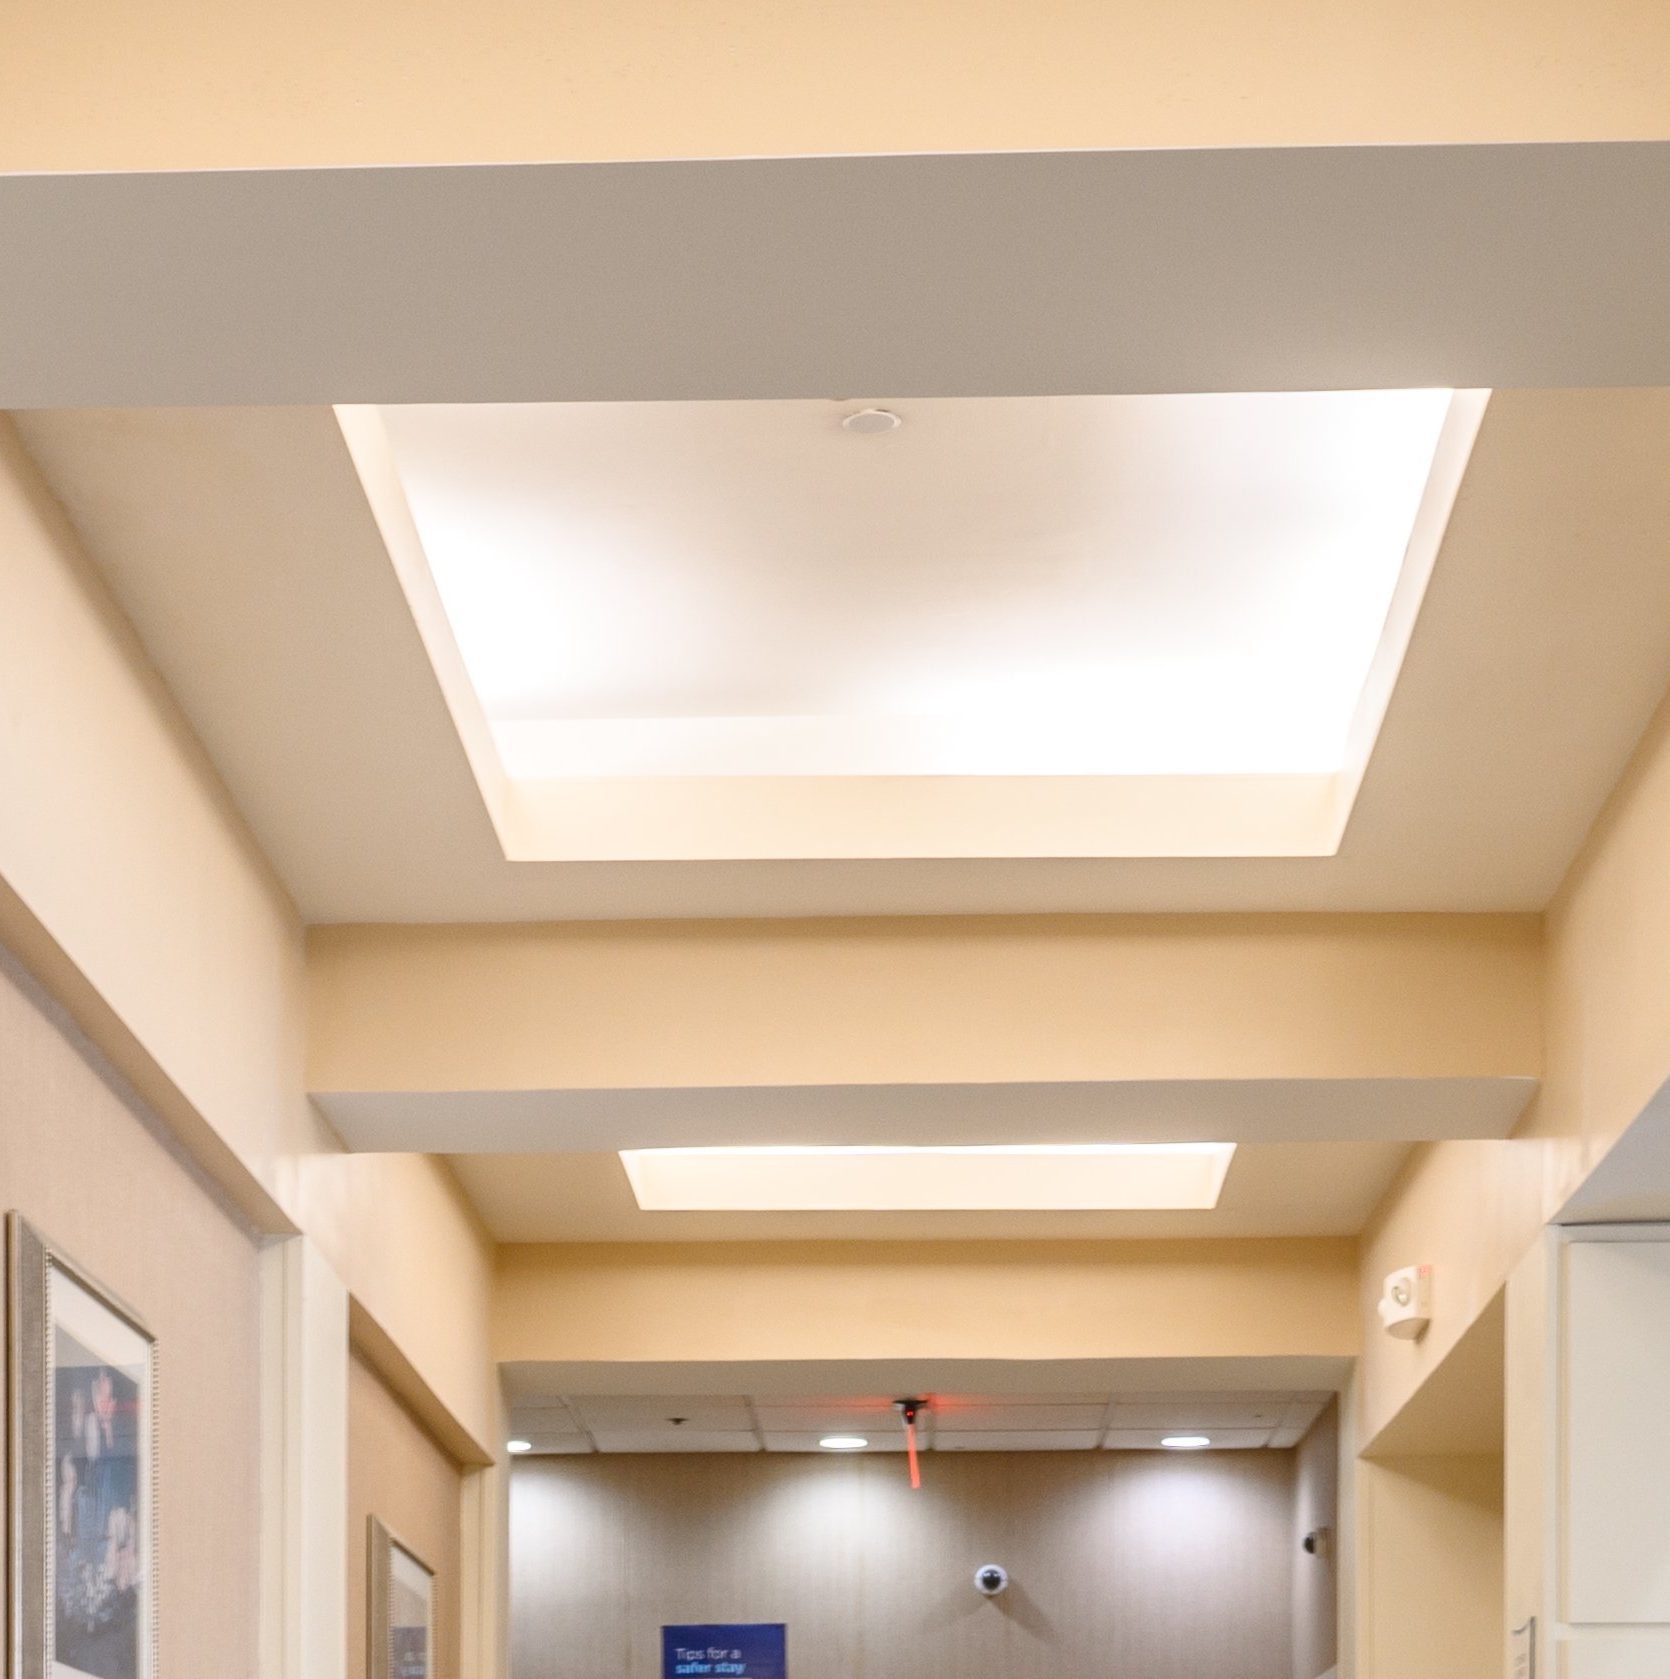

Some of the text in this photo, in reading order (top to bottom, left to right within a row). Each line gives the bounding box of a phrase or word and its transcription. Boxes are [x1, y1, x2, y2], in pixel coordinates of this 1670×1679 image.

[674, 1647, 742, 1661] Tips for a
[675, 1661, 747, 1675] safer stay
